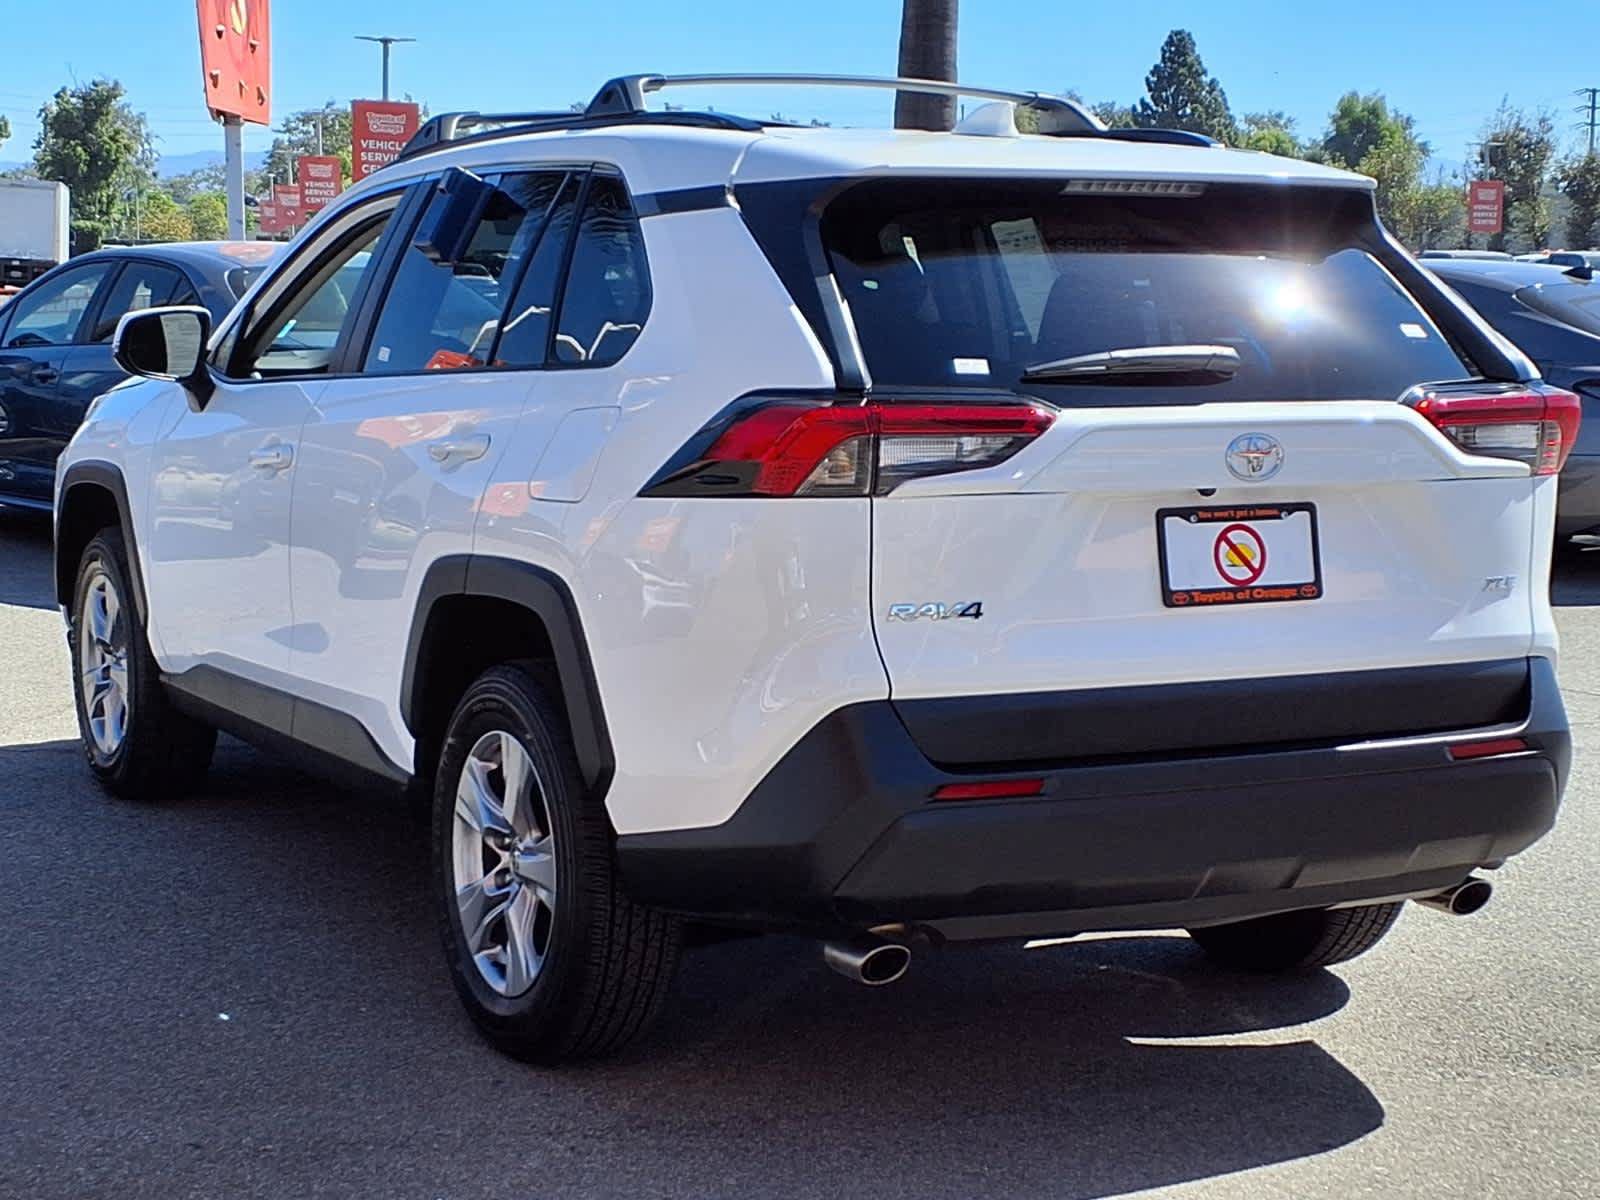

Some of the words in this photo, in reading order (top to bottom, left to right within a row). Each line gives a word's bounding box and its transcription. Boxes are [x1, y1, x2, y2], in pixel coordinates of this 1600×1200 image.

[360, 138, 407, 151] VEHICL
[360, 151, 399, 162] SERVI
[1193, 590, 1234, 602] Toyota
[1236, 589, 1250, 600] of
[1252, 587, 1297, 599] Orange
[887, 601, 983, 620] RAV4
